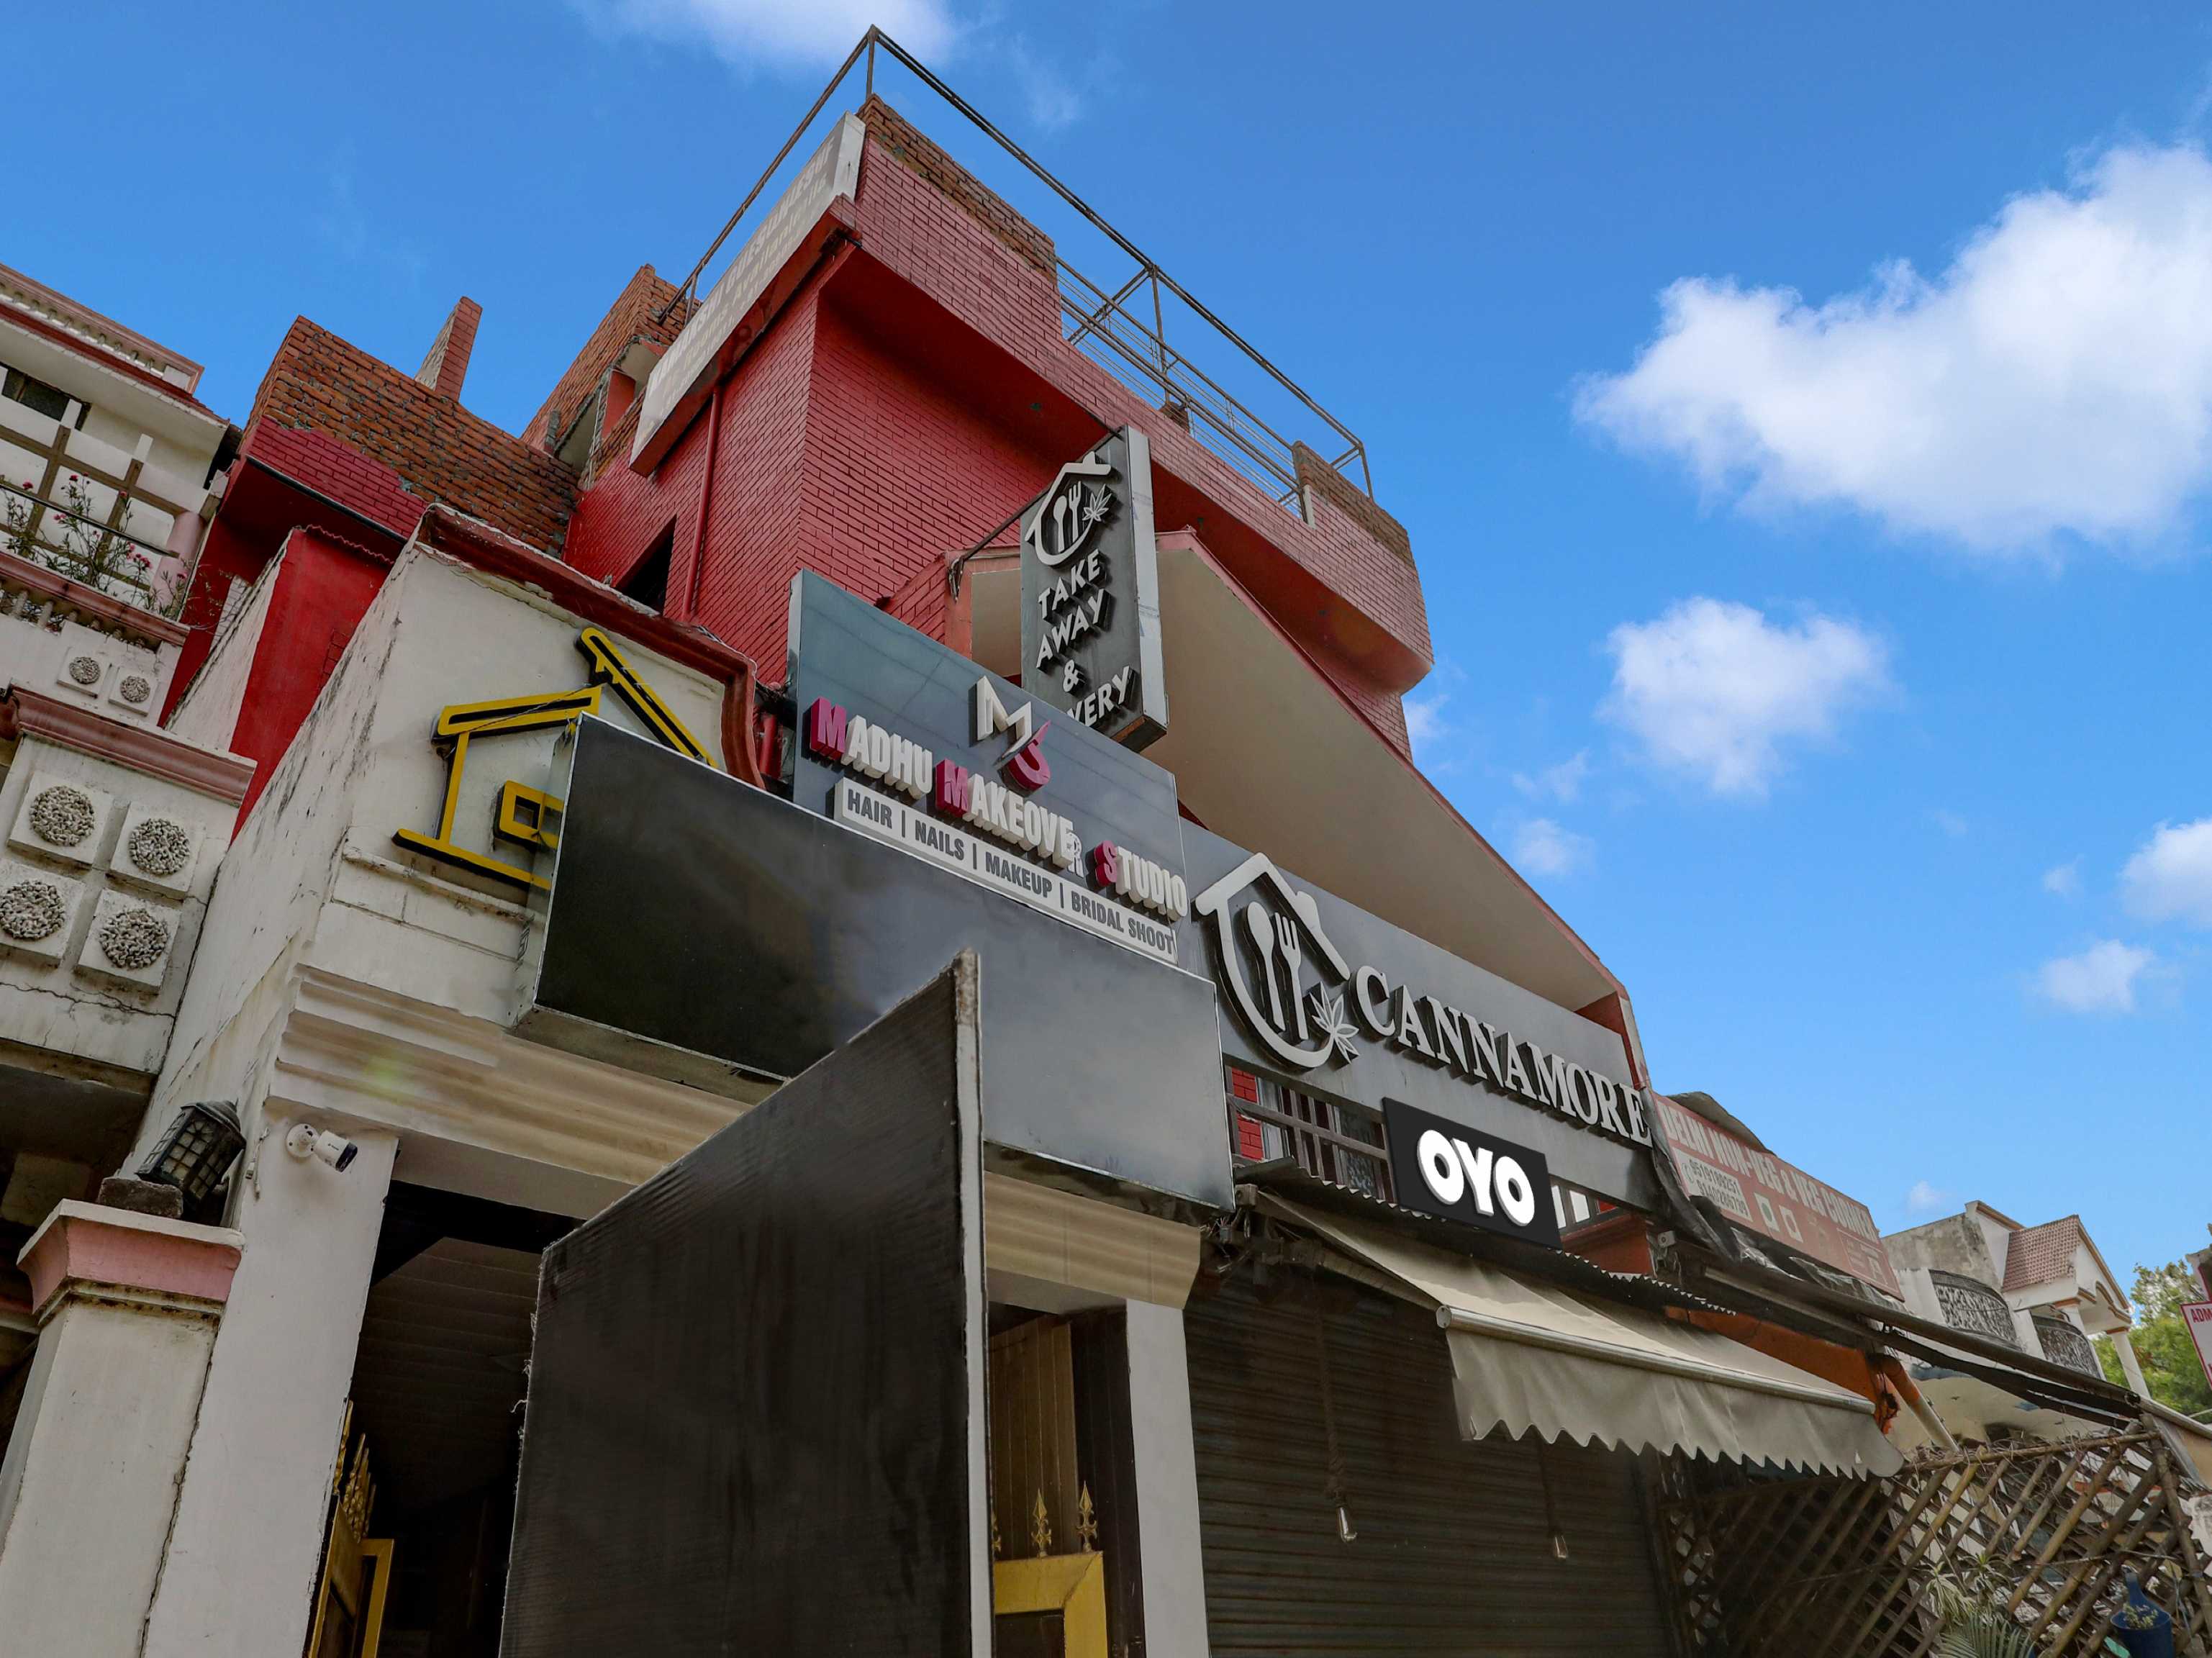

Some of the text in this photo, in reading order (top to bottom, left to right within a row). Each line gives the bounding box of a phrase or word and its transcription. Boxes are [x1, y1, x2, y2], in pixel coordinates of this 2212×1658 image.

[1036, 588, 1105, 669] AWAY
[1038, 548, 1100, 619] TAKE
[1063, 659, 1081, 692] &
[1066, 665, 1130, 728] VERY
[811, 697, 1188, 922] MADHU MAKEOVER STUDIO
[847, 788, 1174, 955] HAIR NAILS MAKEUP BRIDAL SHOOT
[1351, 965, 1652, 1147] CANNAMORE
[1416, 1129, 1536, 1227] OYO
[1657, 1100, 1715, 1159] DELHI
[1789, 1169, 1828, 1218] VEG
